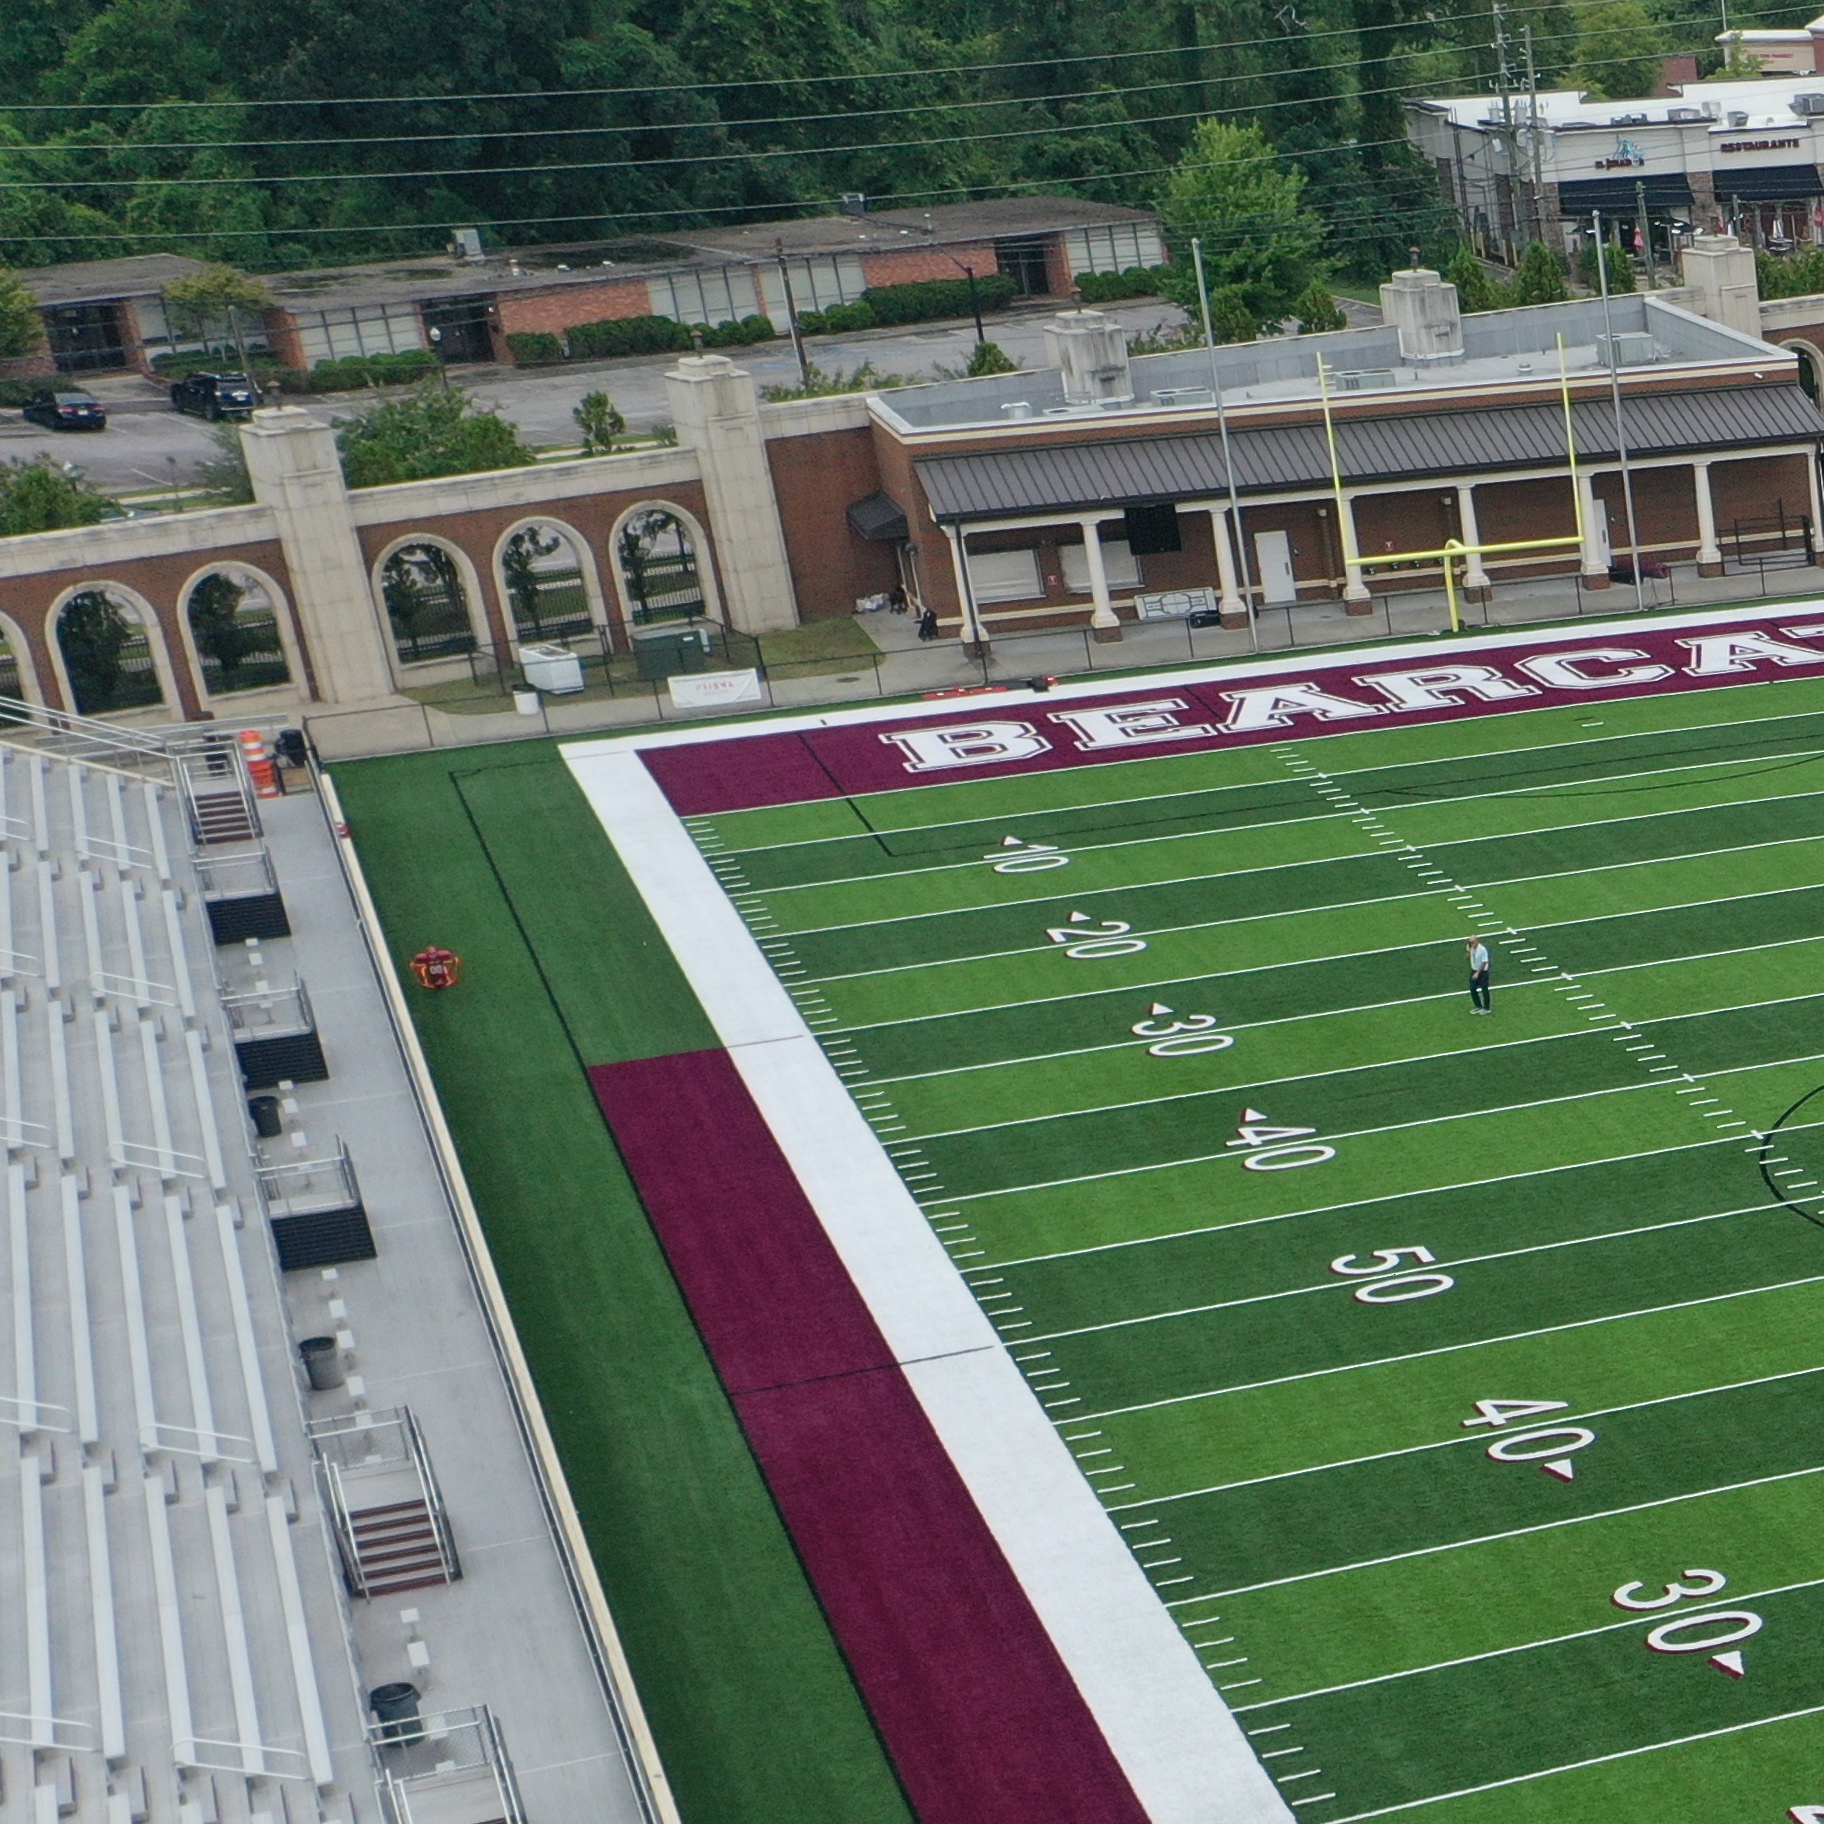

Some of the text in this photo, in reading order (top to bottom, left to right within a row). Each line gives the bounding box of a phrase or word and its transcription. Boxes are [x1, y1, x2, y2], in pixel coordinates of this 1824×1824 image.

[1721, 138, 1800, 153] RESTAURANTE
[984, 843, 1070, 874] 10
[1046, 920, 1147, 960] 20
[1131, 1014, 1235, 1057] 30
[1225, 1126, 1336, 1172] 40
[1330, 1245, 1455, 1304] 50
[1460, 1398, 1597, 1463] 40
[1610, 1568, 1764, 1654] 30
